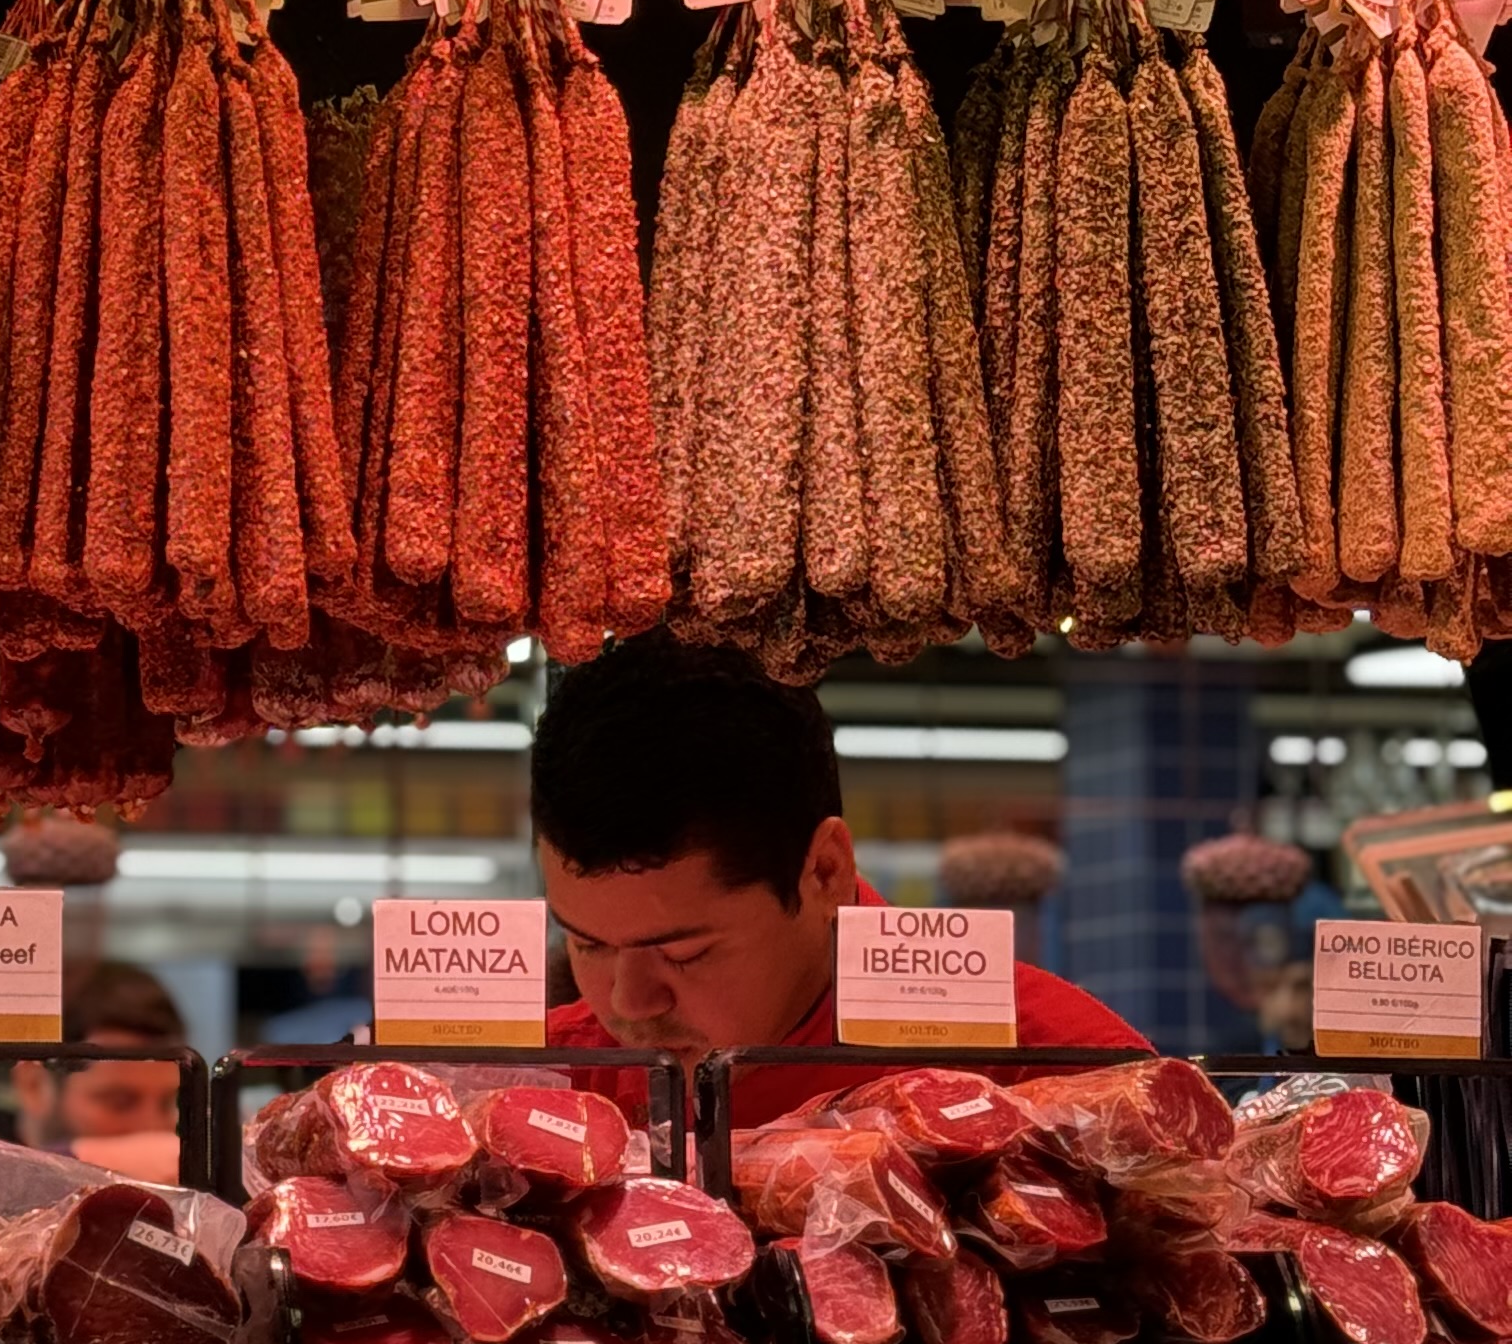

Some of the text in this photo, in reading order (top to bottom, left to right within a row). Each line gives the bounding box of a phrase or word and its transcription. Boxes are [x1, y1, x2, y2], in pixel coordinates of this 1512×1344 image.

[411, 911, 499, 936] LOMO
[880, 911, 968, 938] LOMO
[863, 943, 986, 976] IBÉRICO
[1320, 935, 1474, 959] LOMO IBÉRICO
[385, 948, 528, 974] MATANZA
[1349, 961, 1444, 983] BELLOTA
